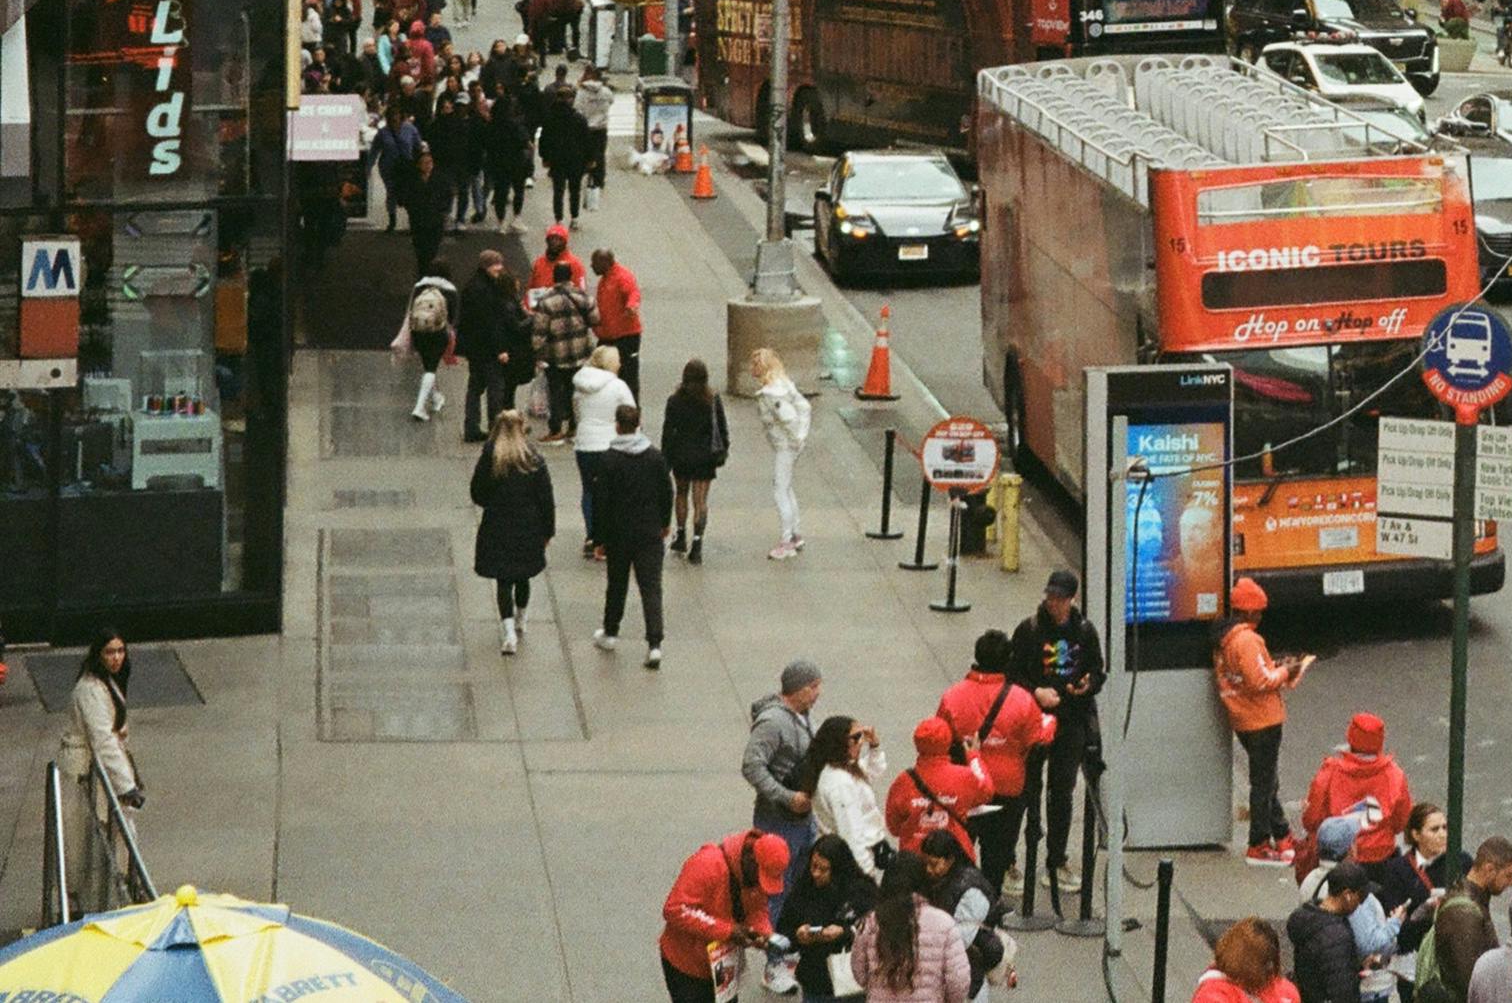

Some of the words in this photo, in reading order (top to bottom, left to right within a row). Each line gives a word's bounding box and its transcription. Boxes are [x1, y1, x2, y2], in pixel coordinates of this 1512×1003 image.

[1079, 9, 1104, 22] 346
[147, 0, 189, 177] Lids
[1452, 219, 1468, 235] 15
[1168, 237, 1186, 254] 15
[1216, 245, 1321, 273] ICONIC
[1327, 239, 1427, 263] TOURS
[1234, 310, 1289, 342] Hop
[1294, 318, 1321, 332] on
[1335, 311, 1374, 335] Hop
[1377, 308, 1408, 335] off
[1180, 374, 1226, 387] LinkNYC
[1429, 372, 1447, 393] NO
[1446, 377, 1507, 404] STANDING
[1389, 521, 1402, 531] Av
[1381, 533, 1390, 543] W
[1393, 533, 1406, 543] 47
[1408, 534, 1419, 545] St
